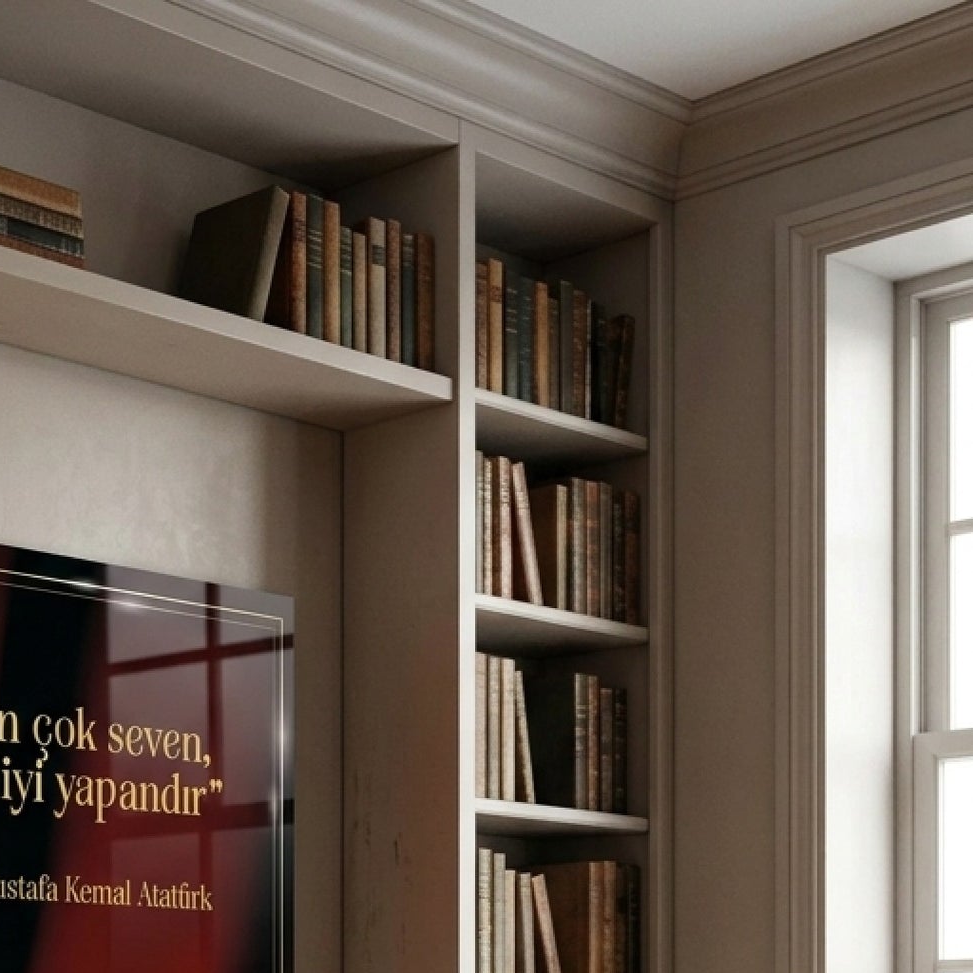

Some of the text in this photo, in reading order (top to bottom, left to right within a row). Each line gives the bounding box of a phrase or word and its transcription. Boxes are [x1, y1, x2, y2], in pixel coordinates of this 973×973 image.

[33, 707, 97, 761] çok
[108, 722, 211, 768] seven,
[1, 755, 44, 816] iyi
[64, 875, 131, 906] Kemal
